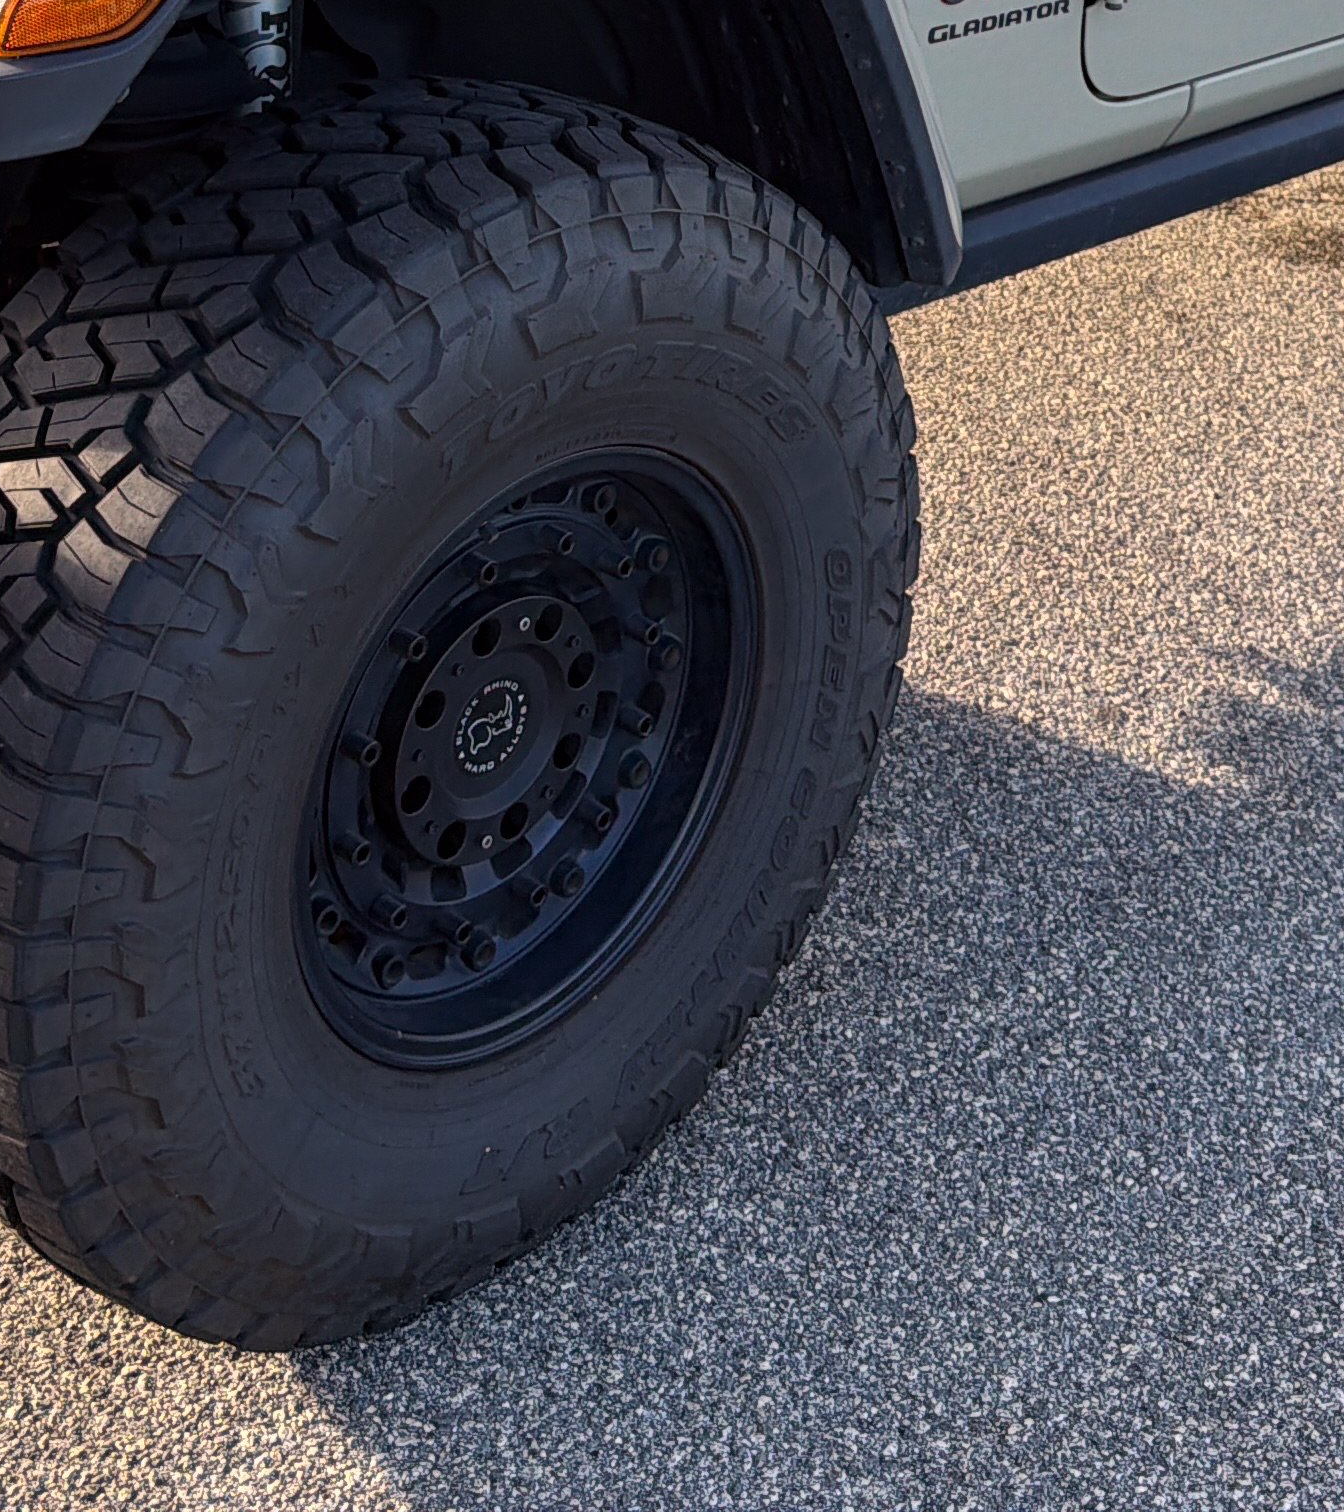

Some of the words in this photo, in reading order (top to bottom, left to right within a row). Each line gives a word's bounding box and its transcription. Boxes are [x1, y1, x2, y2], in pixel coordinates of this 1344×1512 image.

[440, 344, 638, 482] TOYO
[644, 340, 818, 444] TIRES
[809, 545, 853, 753] OPEN
[455, 696, 480, 747] BLACK
[483, 679, 519, 696] RHINO
[463, 760, 495, 775] HARD
[499, 704, 528, 763] ALLOYS
